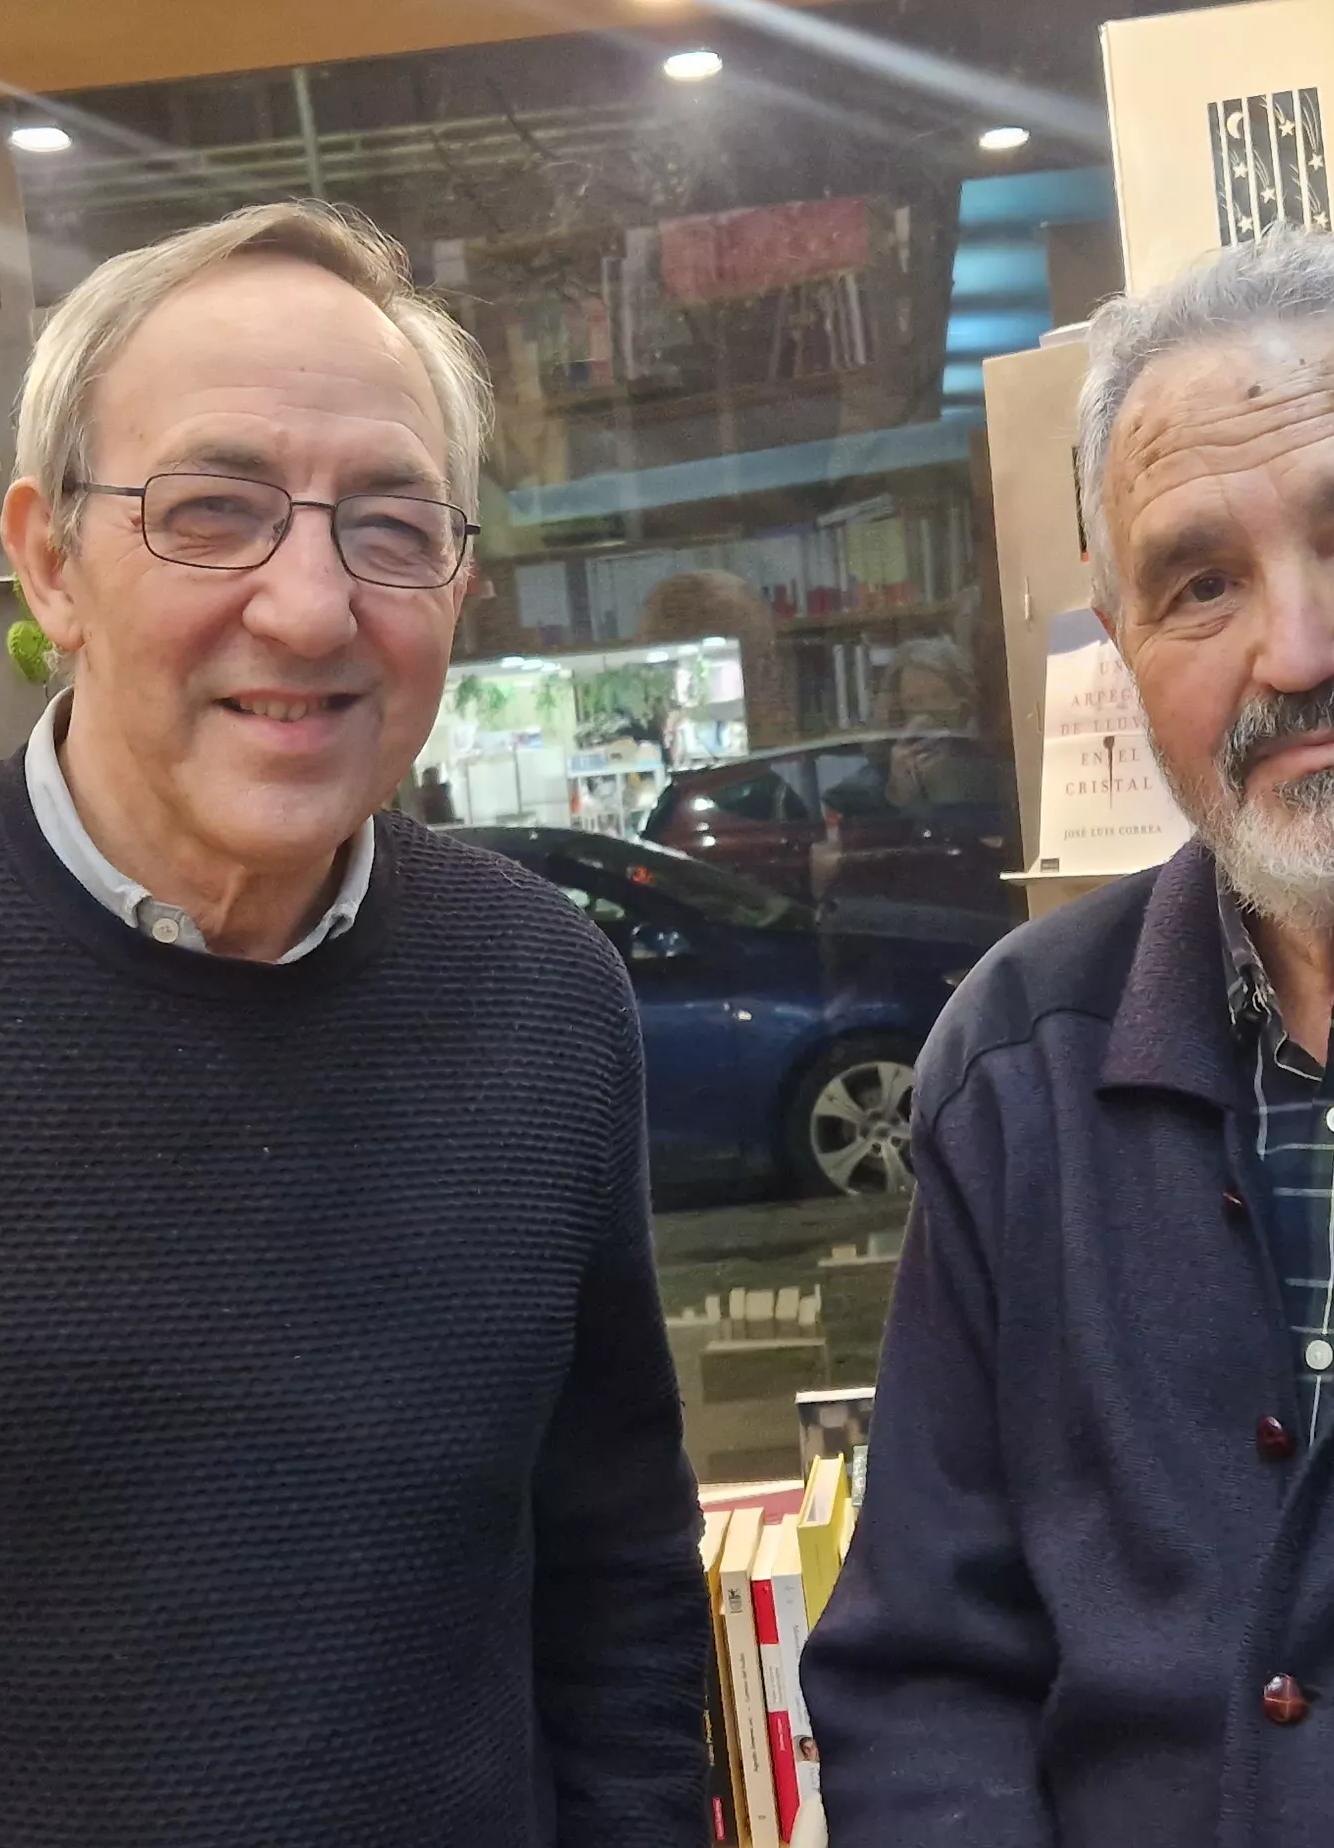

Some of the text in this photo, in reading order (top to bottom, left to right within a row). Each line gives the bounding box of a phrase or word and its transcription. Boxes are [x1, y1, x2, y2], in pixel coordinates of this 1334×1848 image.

[1072, 687, 1131, 708] ARPEG
[1059, 716, 1144, 736] DE LLUV
[1081, 748, 1141, 767] EN EL
[1066, 776, 1152, 796] CRISTAL
[1064, 824, 1163, 841] JOSÉ LUIS CORREA
